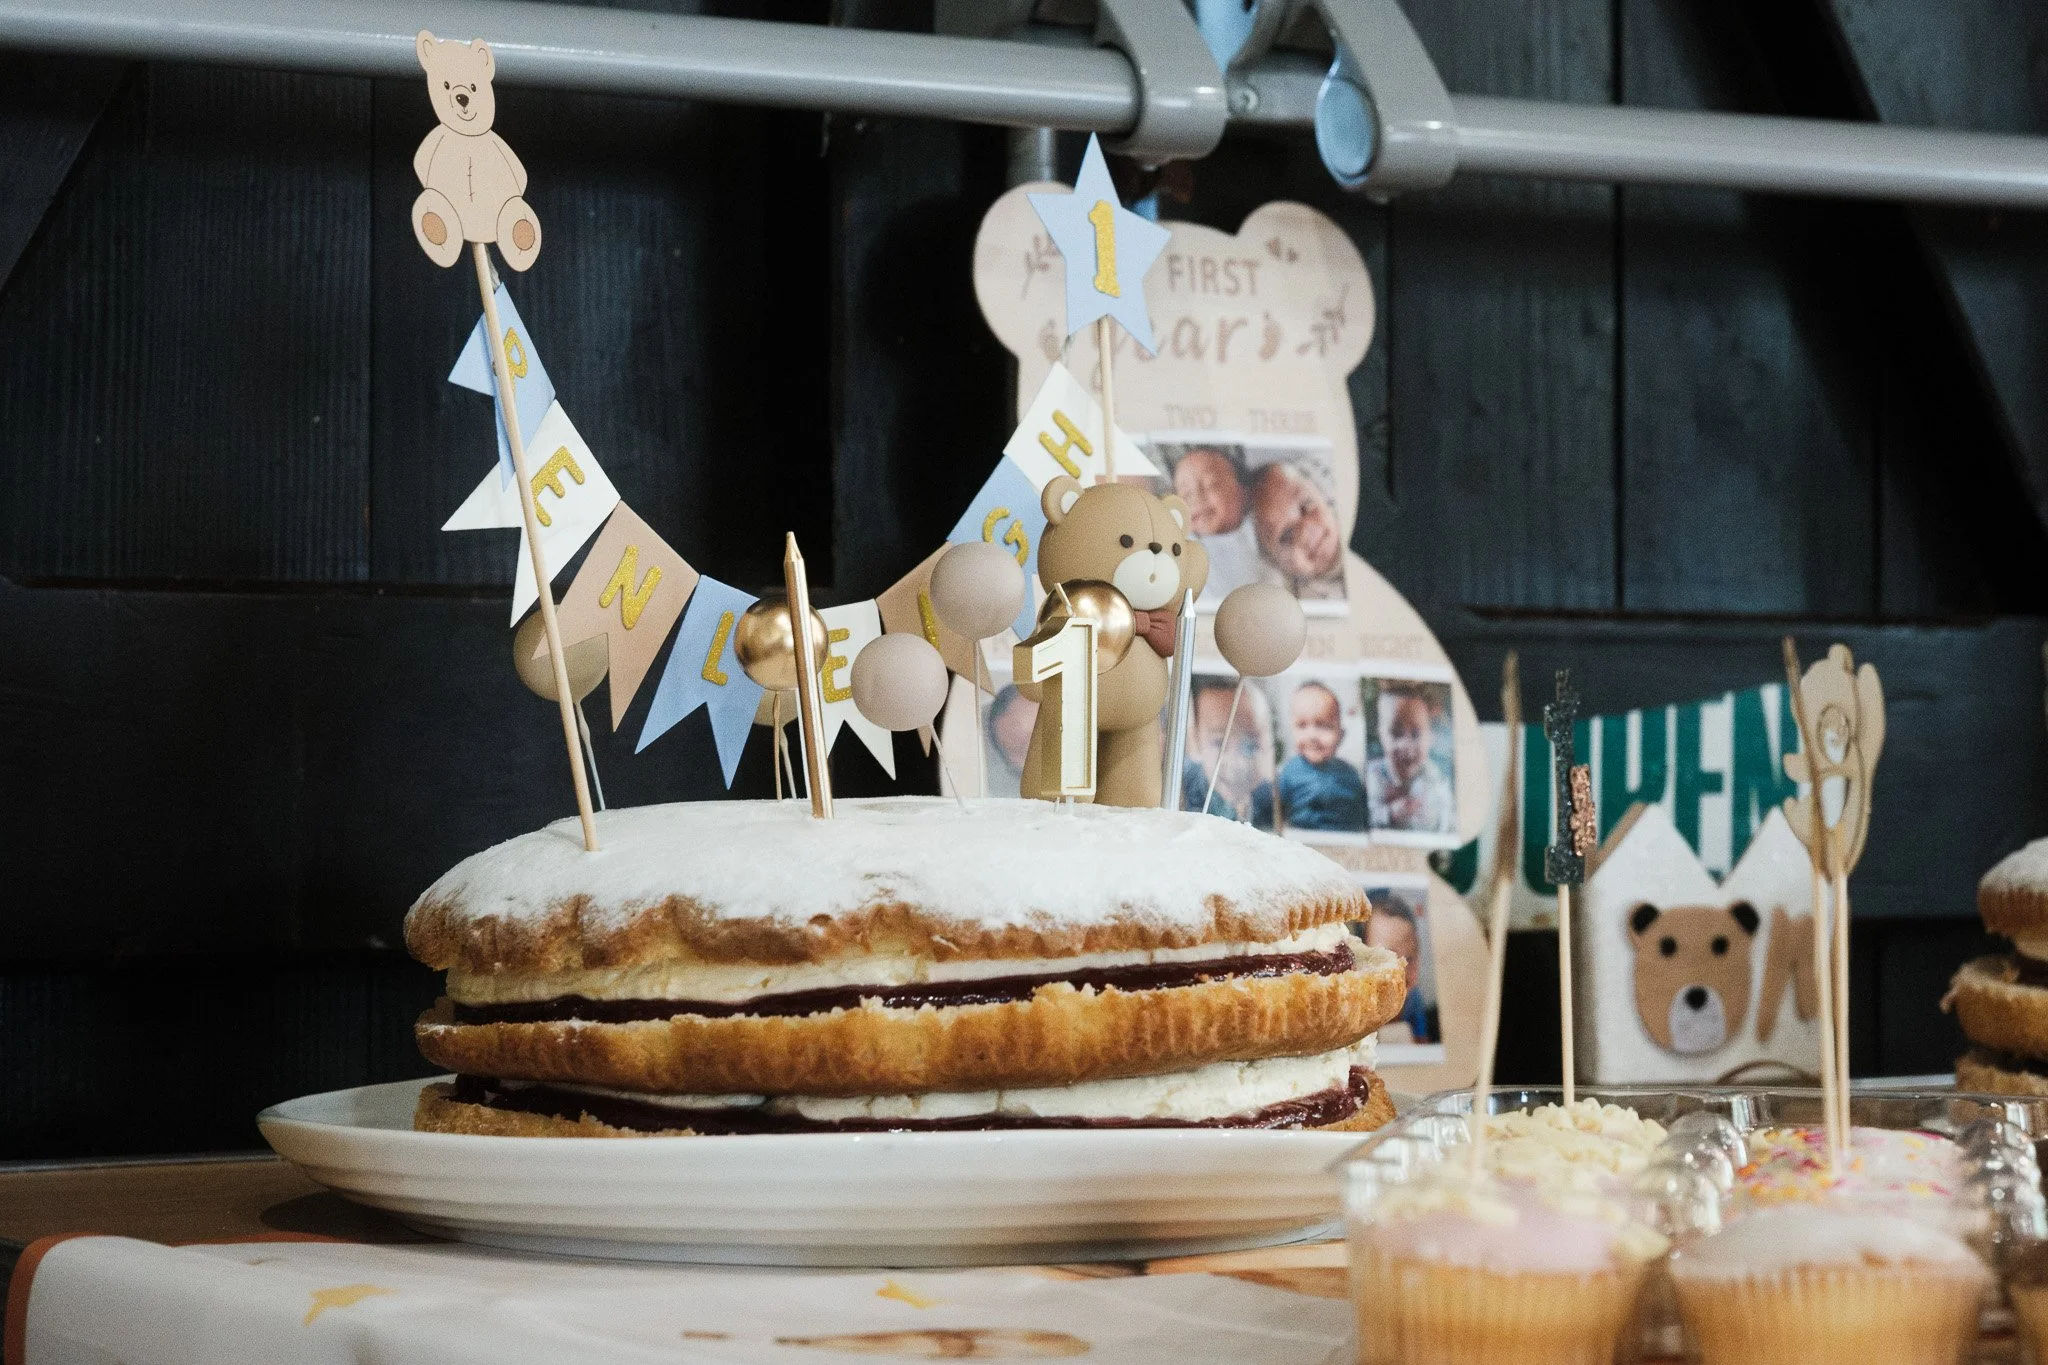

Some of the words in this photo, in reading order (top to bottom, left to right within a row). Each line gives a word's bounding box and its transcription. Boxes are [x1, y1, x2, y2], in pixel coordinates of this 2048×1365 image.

[1087, 199, 1121, 298] 1
[1166, 253, 1260, 297] FIRST
[1090, 315, 1249, 394] yar
[1163, 403, 1219, 431] TWO
[1013, 616, 1098, 803] 1
